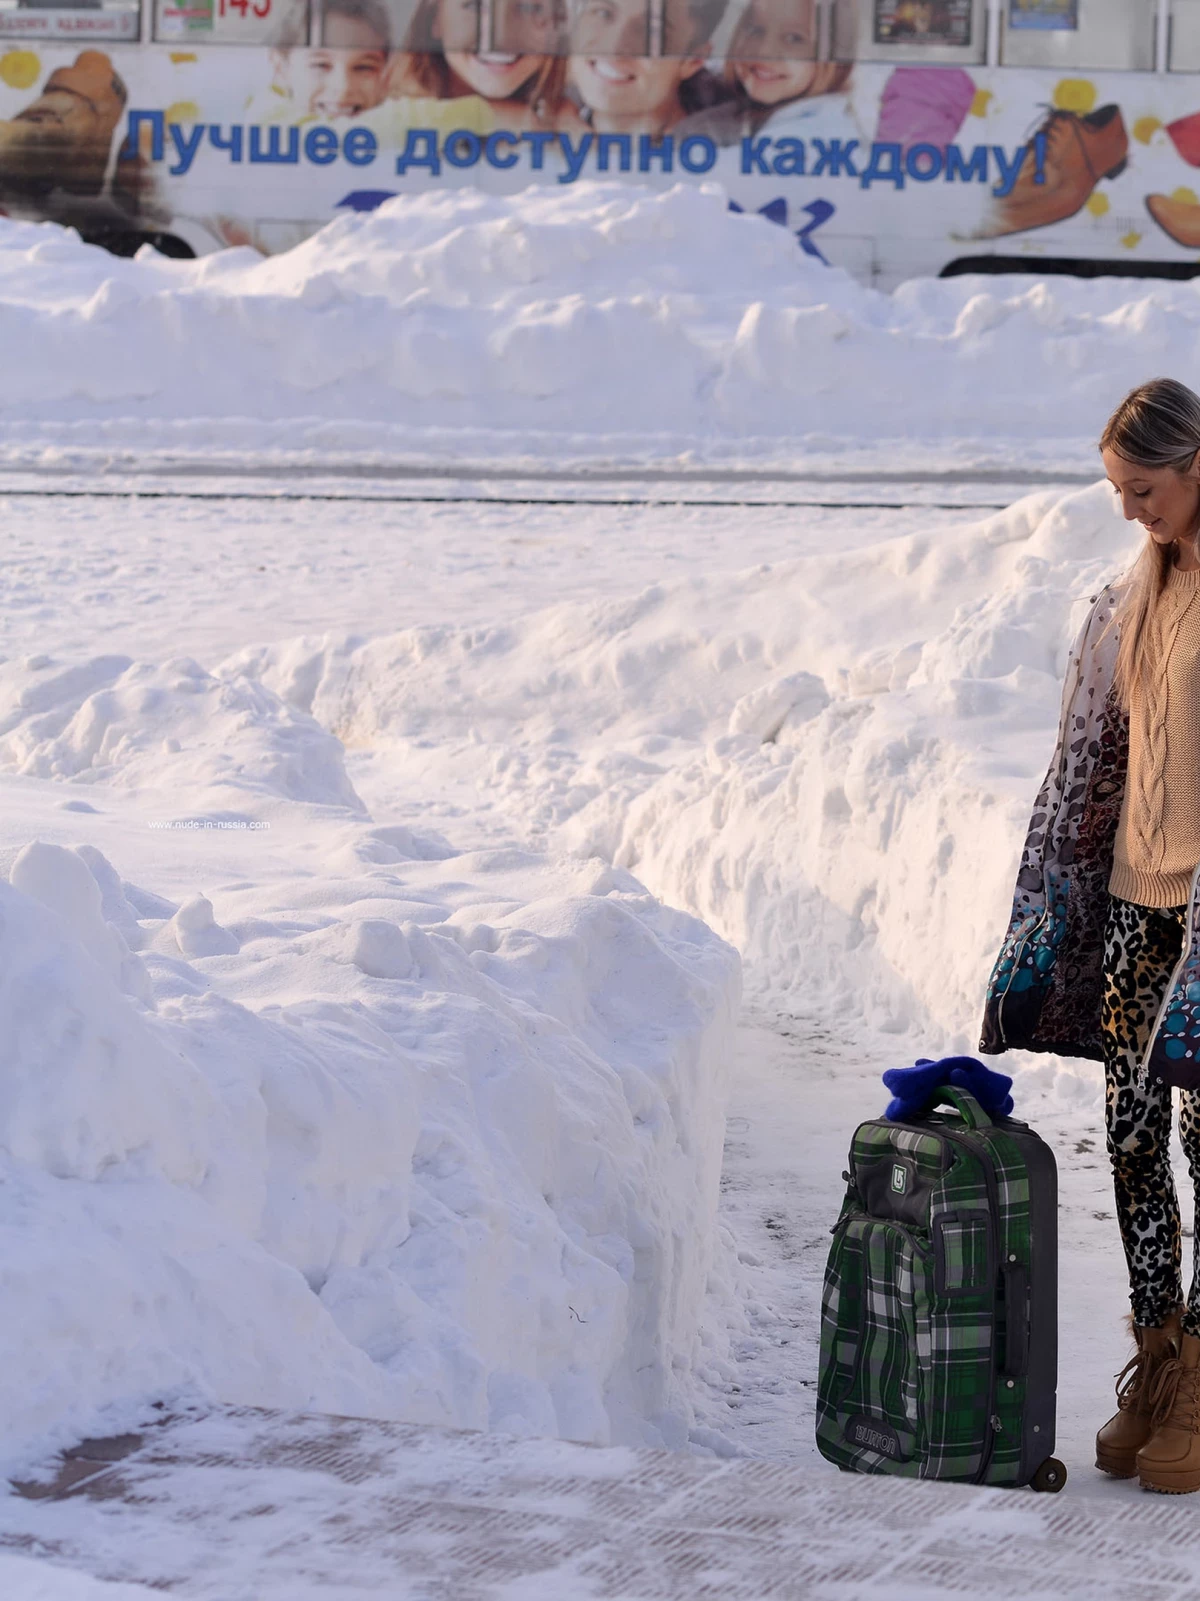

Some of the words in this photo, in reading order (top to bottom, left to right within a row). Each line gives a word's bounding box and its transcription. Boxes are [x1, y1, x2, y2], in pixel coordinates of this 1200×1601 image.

[122, 110, 378, 175] Лучшее
[396, 129, 717, 183] доступно
[740, 132, 1047, 197] каждому!
[855, 1424, 896, 1455] BURTON
